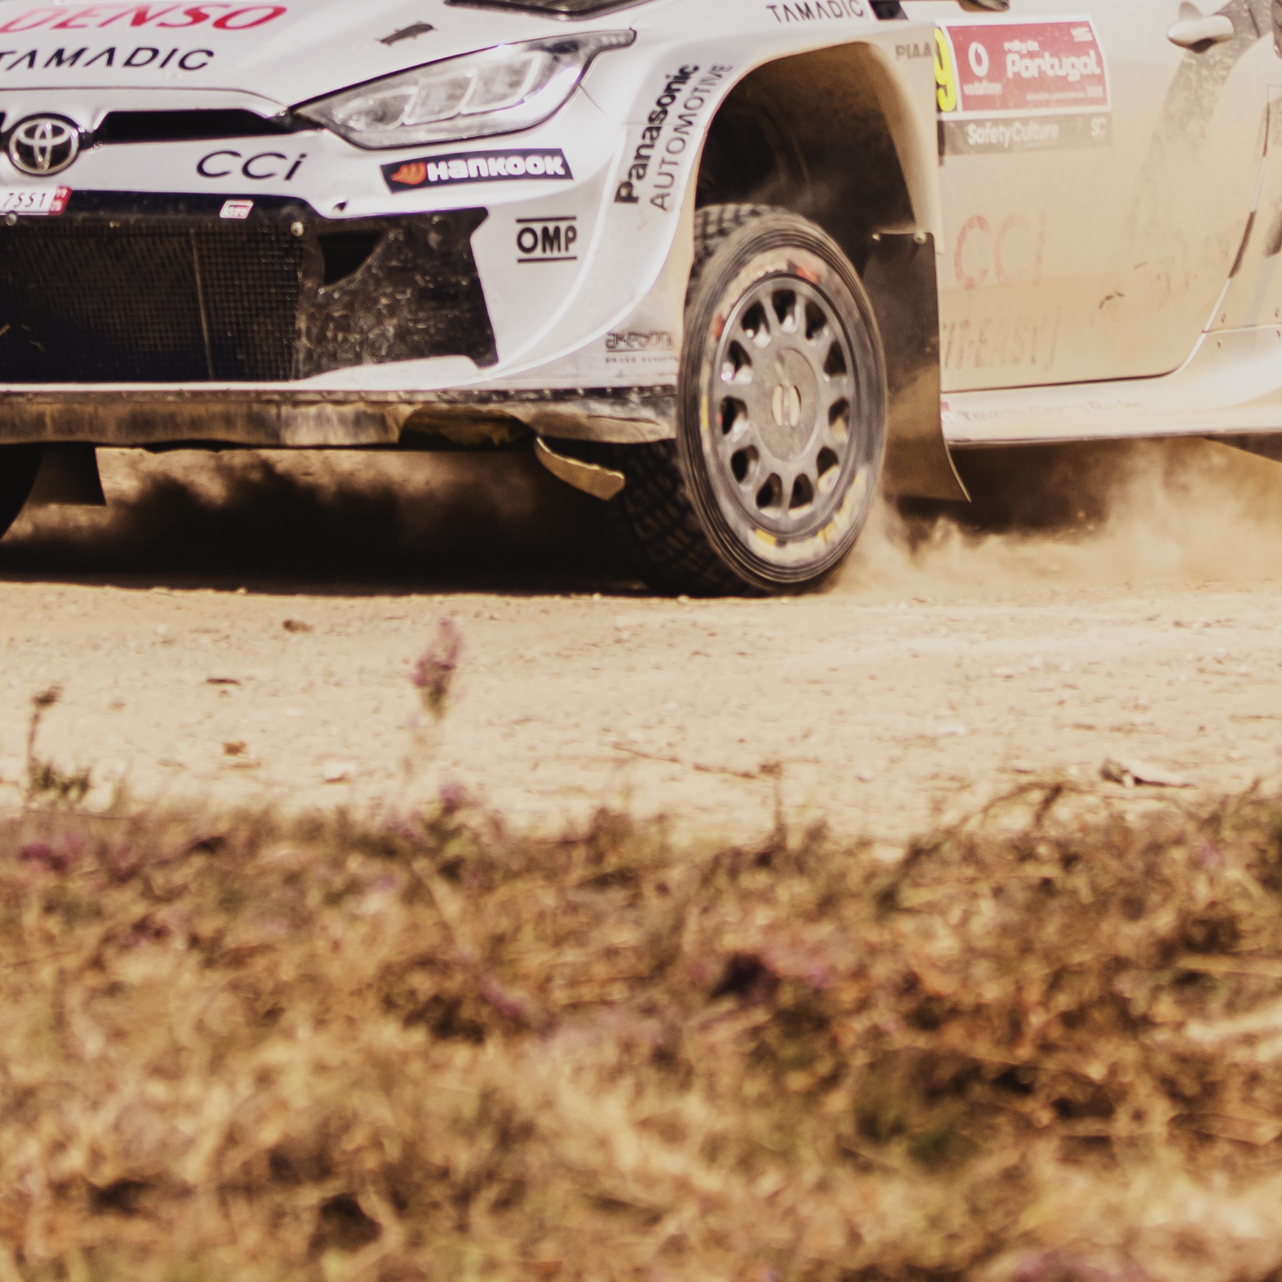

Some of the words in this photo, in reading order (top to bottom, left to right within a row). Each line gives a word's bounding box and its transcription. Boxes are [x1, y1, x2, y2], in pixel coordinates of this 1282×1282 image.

[1005, 49, 1102, 82] Portugal
[614, 65, 700, 204] Panasonic
[650, 64, 732, 211] AUTOMOTIVE
[517, 225, 577, 254] OMP
